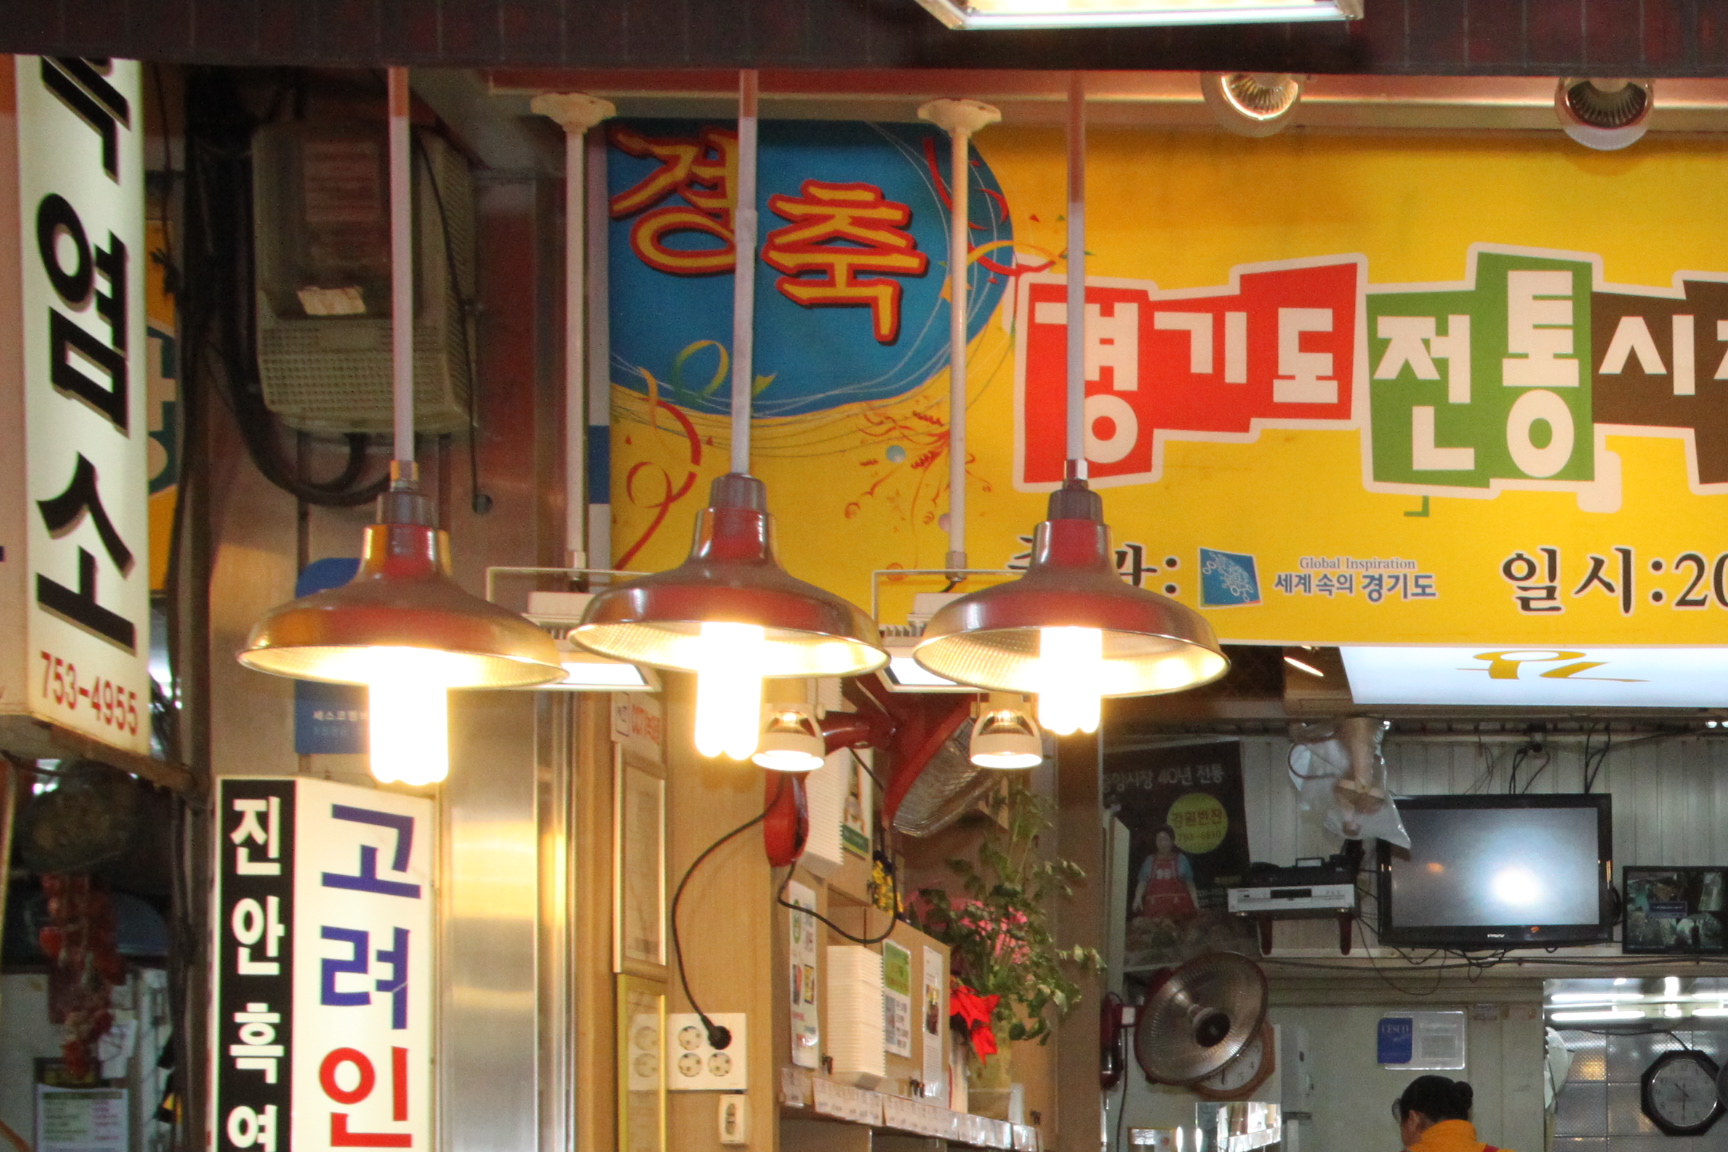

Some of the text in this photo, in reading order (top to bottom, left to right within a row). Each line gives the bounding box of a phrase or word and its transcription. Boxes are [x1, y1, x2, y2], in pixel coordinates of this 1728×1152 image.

[609, 124, 927, 343] 경축
[1035, 300, 1338, 464] 경기도
[1274, 572, 1437, 603] 세계 속의 경기도
[1299, 556, 1417, 573] Global Inspiration
[41, 651, 138, 736] 753-4955
